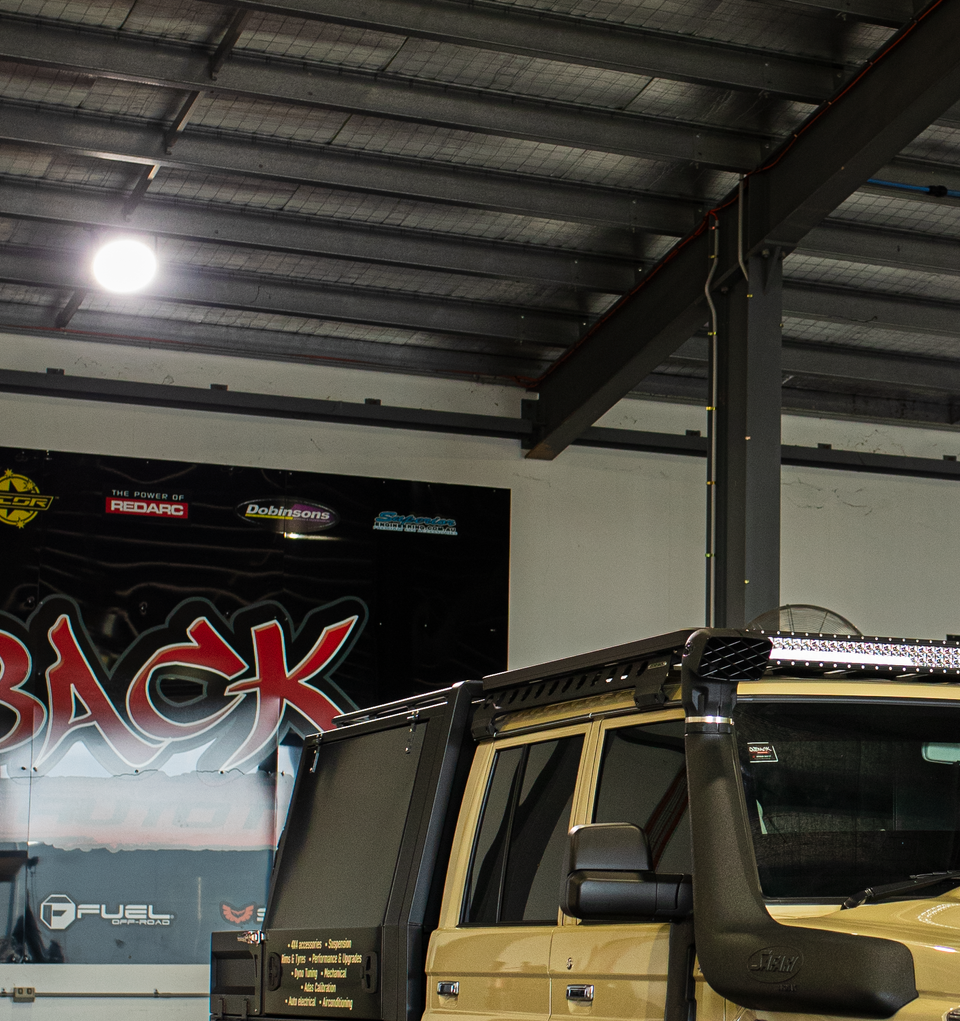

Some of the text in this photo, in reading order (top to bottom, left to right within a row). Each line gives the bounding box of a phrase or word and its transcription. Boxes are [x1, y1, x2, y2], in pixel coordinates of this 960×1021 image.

[134, 491, 168, 500] POWER
[111, 500, 184, 516] REDARC
[246, 503, 330, 520] Dobinsons
[77, 904, 171, 920] FUEL
[298, 938, 322, 950] accessories
[328, 938, 352, 950] Suspension
[296, 954, 306, 966] Tyres
[312, 953, 338, 964] Performance
[342, 952, 362, 966] Upgrades
[294, 967, 318, 980] Dyno Tuning
[324, 967, 348, 978] Mechanical
[314, 982, 336, 992] Calibration
[288, 996, 316, 1006] Auto electrical
